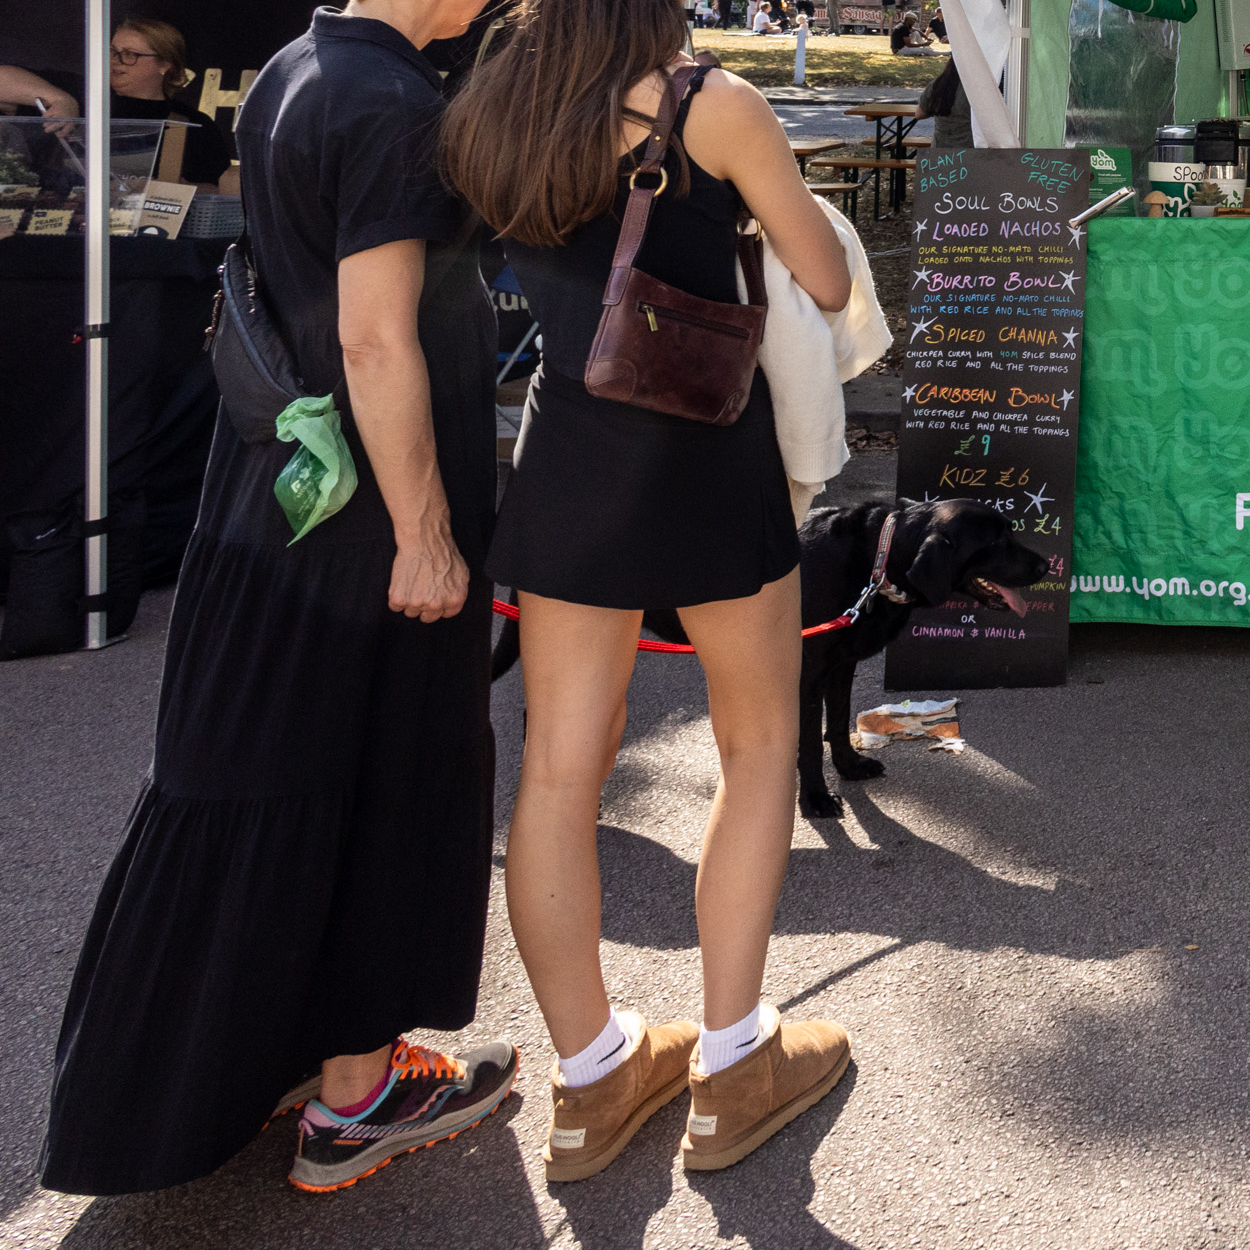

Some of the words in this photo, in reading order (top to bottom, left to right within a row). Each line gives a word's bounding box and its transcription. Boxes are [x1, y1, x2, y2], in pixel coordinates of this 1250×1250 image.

[842, 7, 881, 20] Sausag
[920, 150, 967, 173] PLANT
[1020, 153, 1084, 181] GLUTEN
[1092, 156, 1115, 169] yom
[920, 167, 968, 193] BASED
[1027, 172, 1071, 193] FREE
[144, 201, 182, 214] BROWNIE
[934, 192, 990, 214] SOUL
[999, 192, 1059, 213] BOWLS
[933, 221, 989, 241] LOADED
[1000, 221, 1061, 239] NACHOS
[918, 247, 938, 255] OUR
[942, 246, 988, 254] SIGNATURE
[991, 246, 1032, 254] NO-MATO
[918, 256, 949, 264] LOADED
[1038, 256, 1074, 264] TOPPINGS
[927, 273, 996, 291] BURRITO
[1004, 272, 1061, 292] BOWL
[925, 324, 986, 344] SPICED
[999, 326, 1058, 347] CHANNA
[915, 382, 997, 404] CARIBBEAN
[1008, 387, 1060, 408] BOWL
[939, 464, 988, 488] KIDZ
[995, 467, 1030, 488] £6
